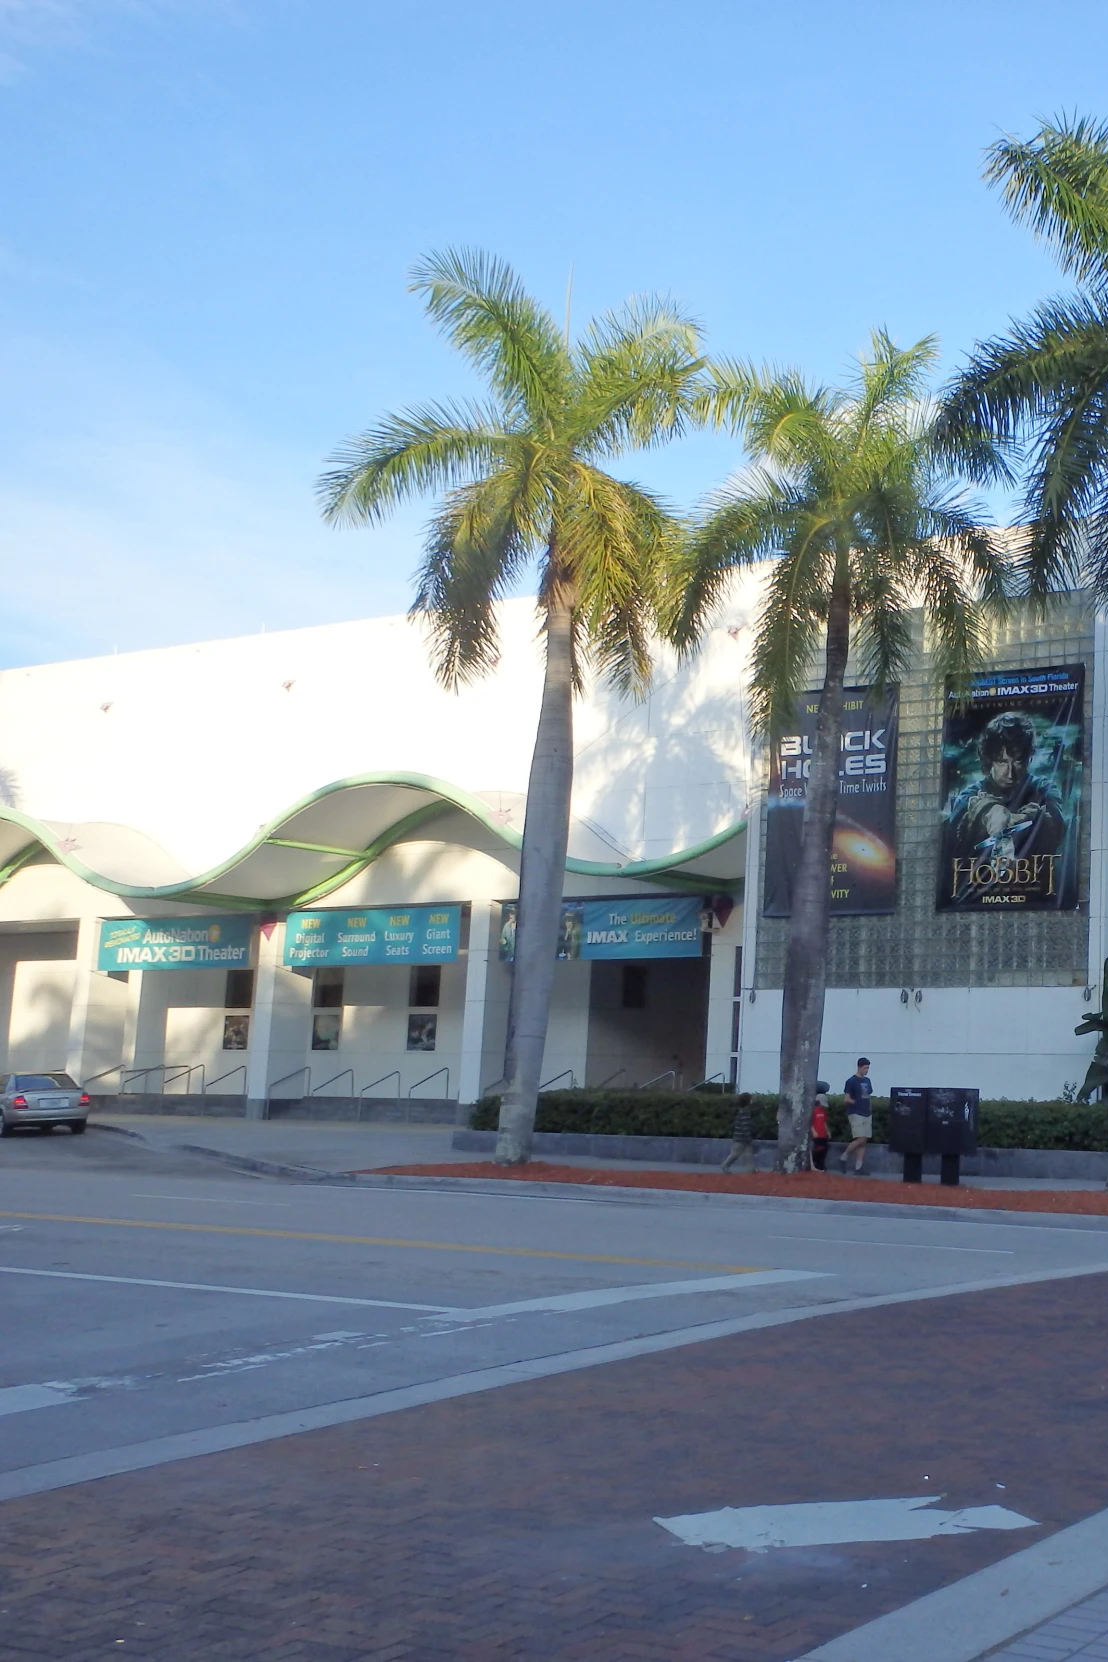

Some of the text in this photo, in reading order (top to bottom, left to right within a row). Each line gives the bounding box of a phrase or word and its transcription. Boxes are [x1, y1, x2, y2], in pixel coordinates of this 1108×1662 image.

[998, 676, 1020, 685] Screen
[1020, 675, 1027, 683] in
[1028, 674, 1046, 683] South
[1047, 672, 1069, 681] Florida
[1049, 681, 1079, 692] Theater
[806, 704, 819, 714] NE
[780, 728, 886, 756] BLCK
[779, 784, 803, 798] Space
[839, 779, 860, 794] Time
[862, 776, 887, 793] Twists
[951, 853, 1063, 898] HOBBIT
[301, 918, 321, 930] NEW
[347, 917, 367, 928] NEW
[389, 915, 411, 926] NEW
[428, 913, 450, 925] NEW
[608, 911, 677, 926] The Ultimate
[142, 927, 209, 945] AutoNation
[295, 932, 325, 946] Digital
[337, 931, 376, 943] Surround
[384, 930, 414, 943] Luxury
[426, 928, 451, 940] Giant
[586, 928, 697, 945] IMAX Experience!
[196, 944, 246, 961] Theater
[289, 947, 329, 961] Projector
[342, 946, 369, 957] Sound
[386, 944, 410, 956] Seats
[422, 943, 452, 955] Screen
